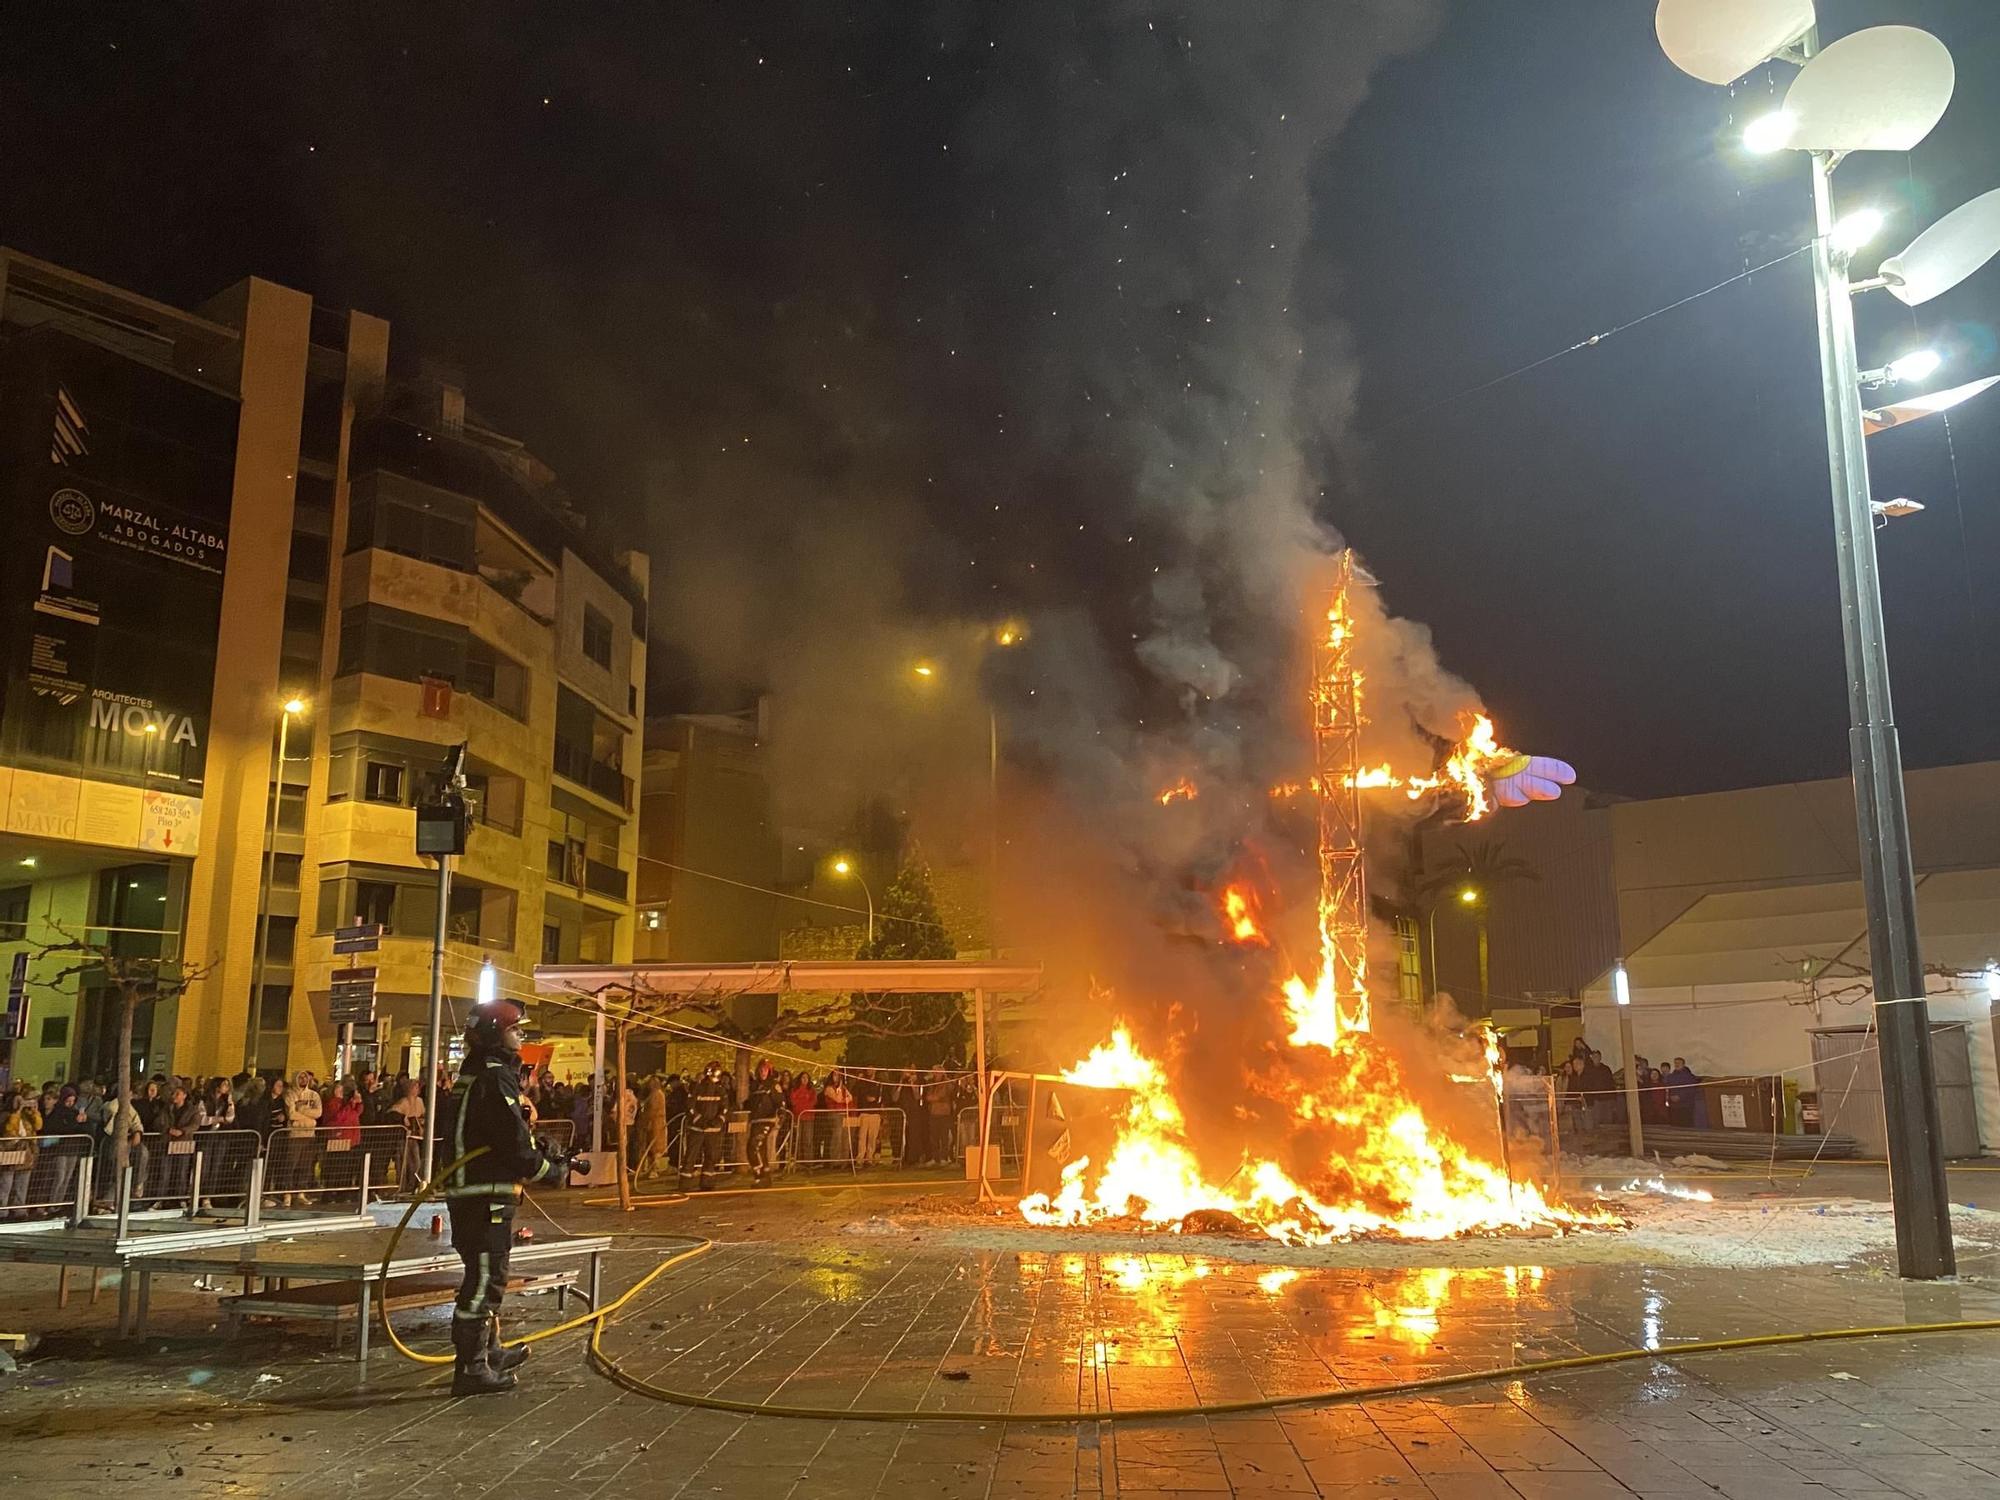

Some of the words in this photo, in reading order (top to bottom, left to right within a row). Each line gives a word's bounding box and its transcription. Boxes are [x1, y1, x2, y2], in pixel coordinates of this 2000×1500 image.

[100, 501, 161, 532] MARZAL
[171, 524, 225, 551] ALTABA
[114, 524, 205, 559] ABOGADOS
[91, 689, 153, 709] ARQUITECTES
[89, 698, 198, 748] MOYA
